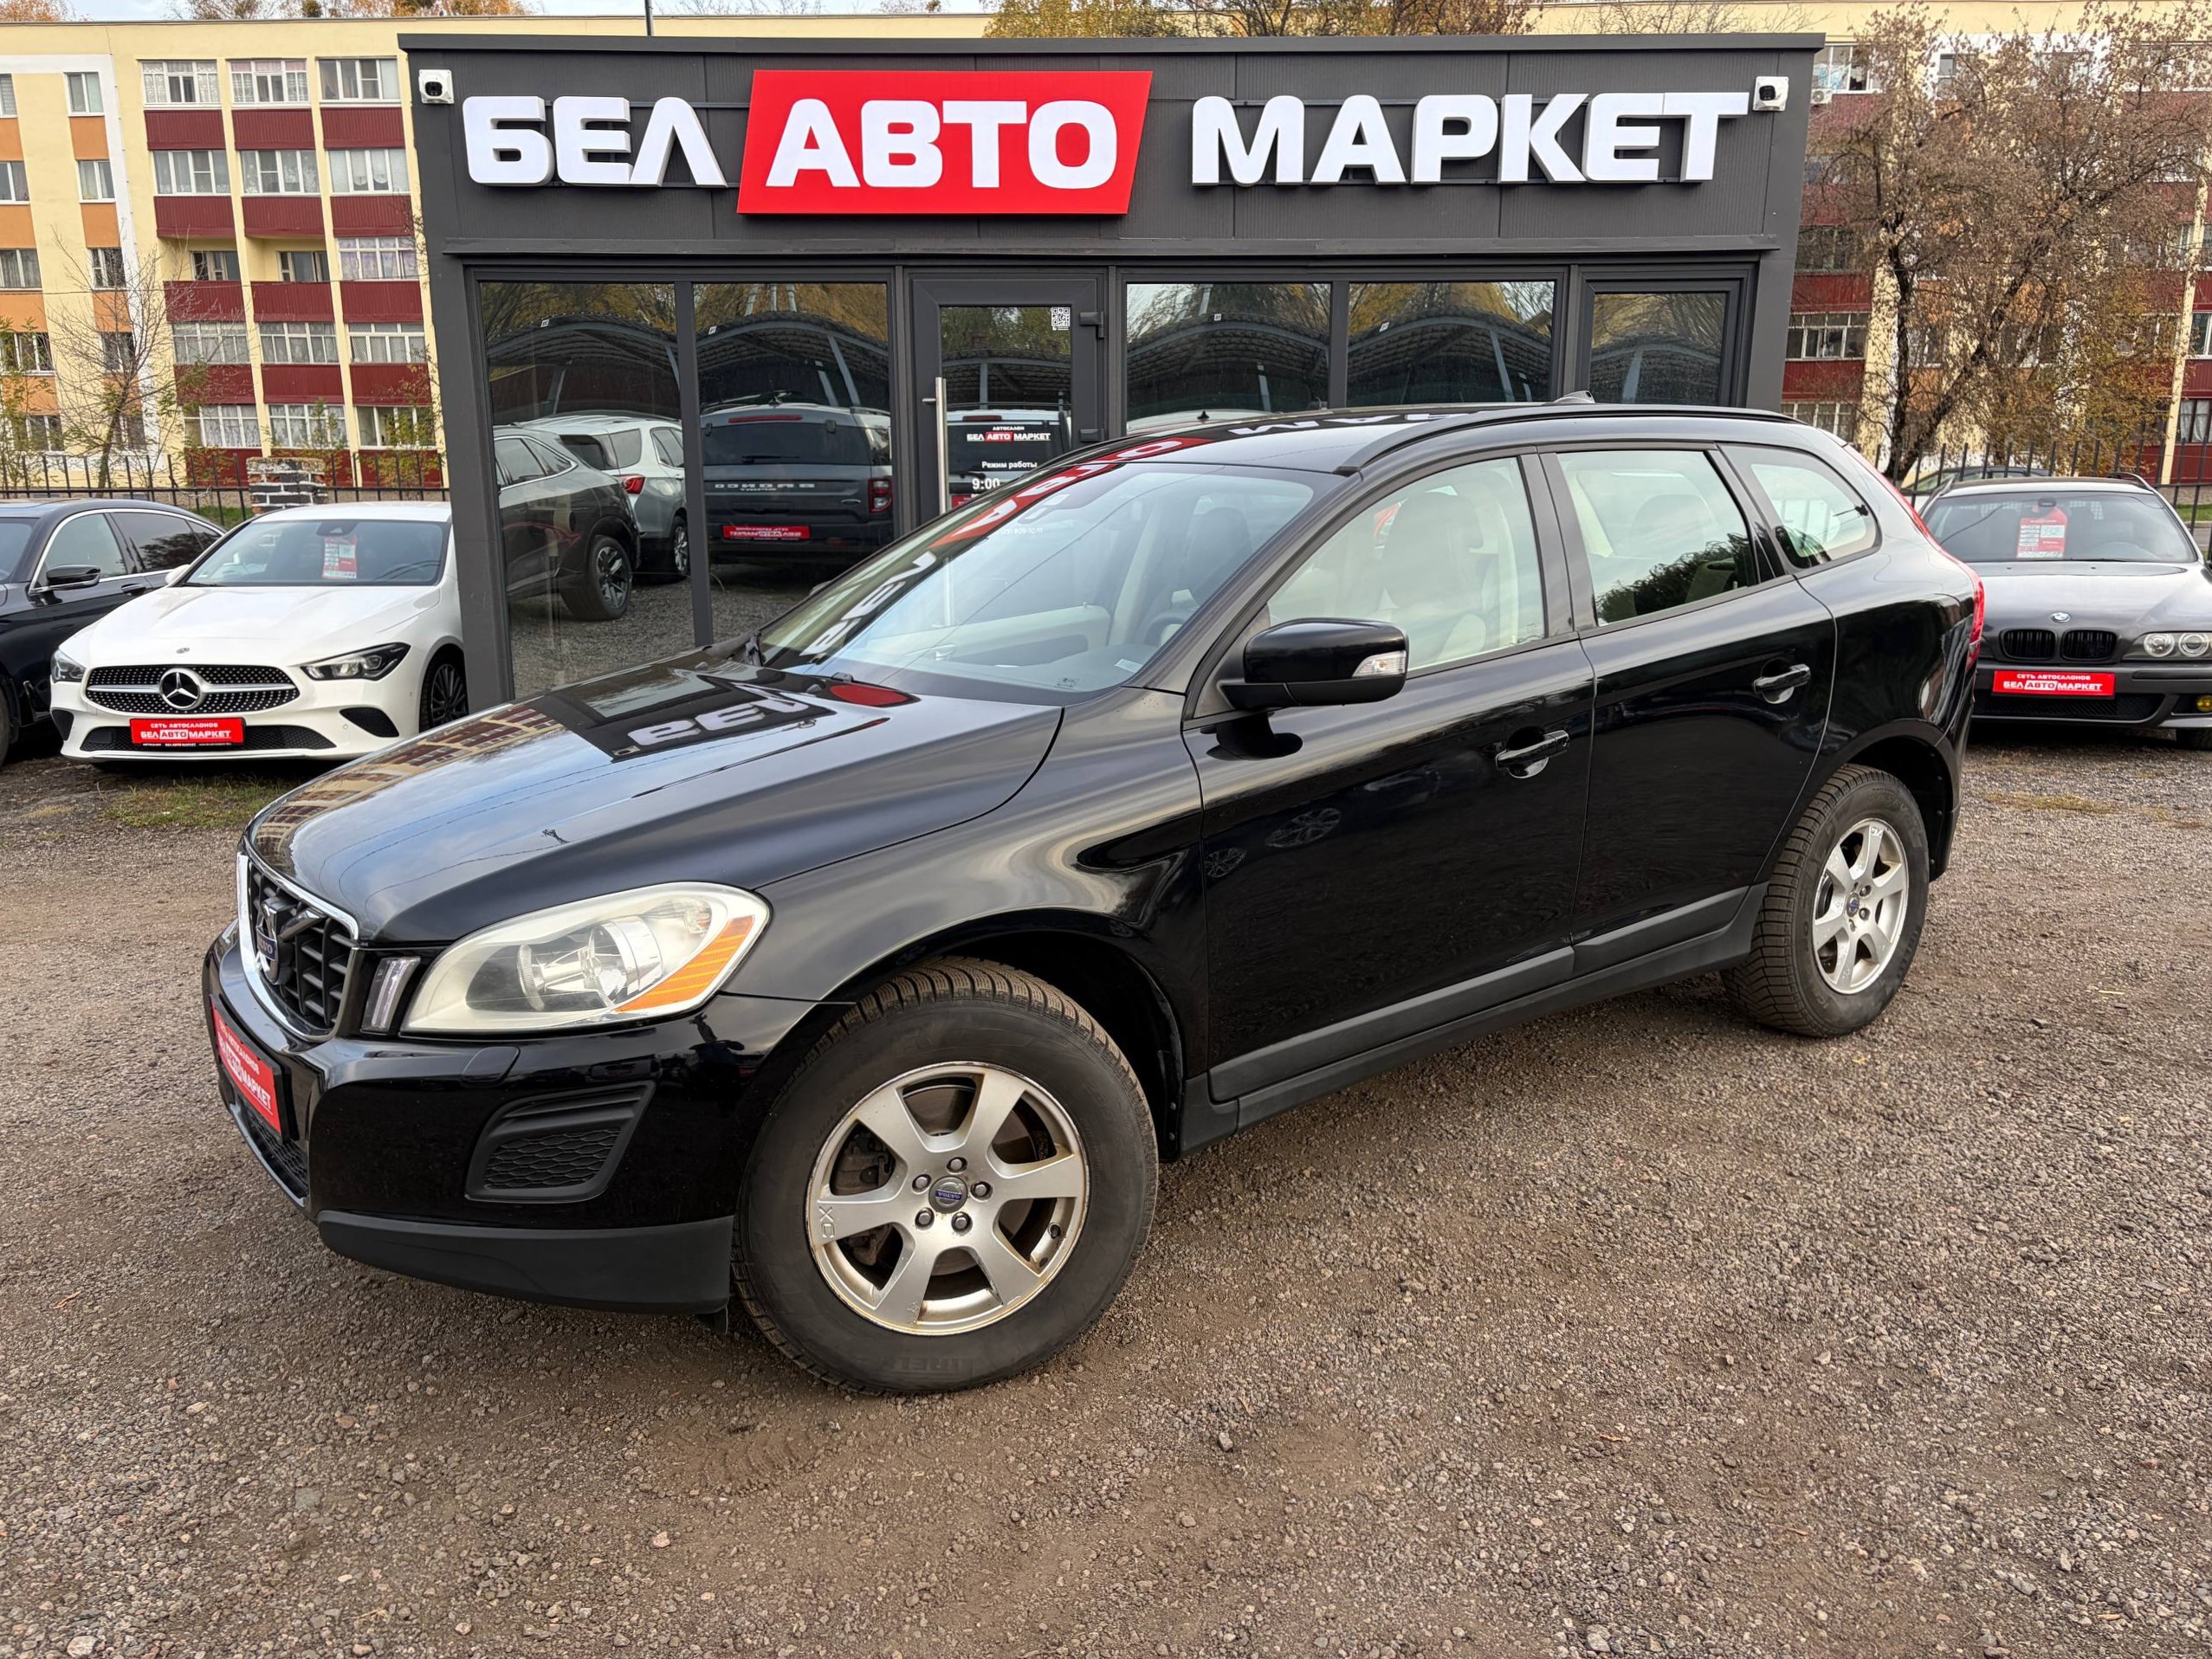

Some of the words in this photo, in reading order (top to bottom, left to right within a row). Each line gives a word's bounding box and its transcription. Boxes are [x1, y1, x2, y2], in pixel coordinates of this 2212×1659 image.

[462, 96, 728, 188] БЕЛ
[766, 99, 1118, 188] АВТО
[1192, 93, 1750, 185] МАРКЕТ
[1008, 461, 1038, 469] работы
[972, 478, 1000, 490] 9:00
[2002, 681, 2024, 689] БЕЛ
[2057, 682, 2103, 691] МАРКЕТ
[190, 730, 231, 739] МАРКЕТ
[818, 1206, 836, 1238] XC
